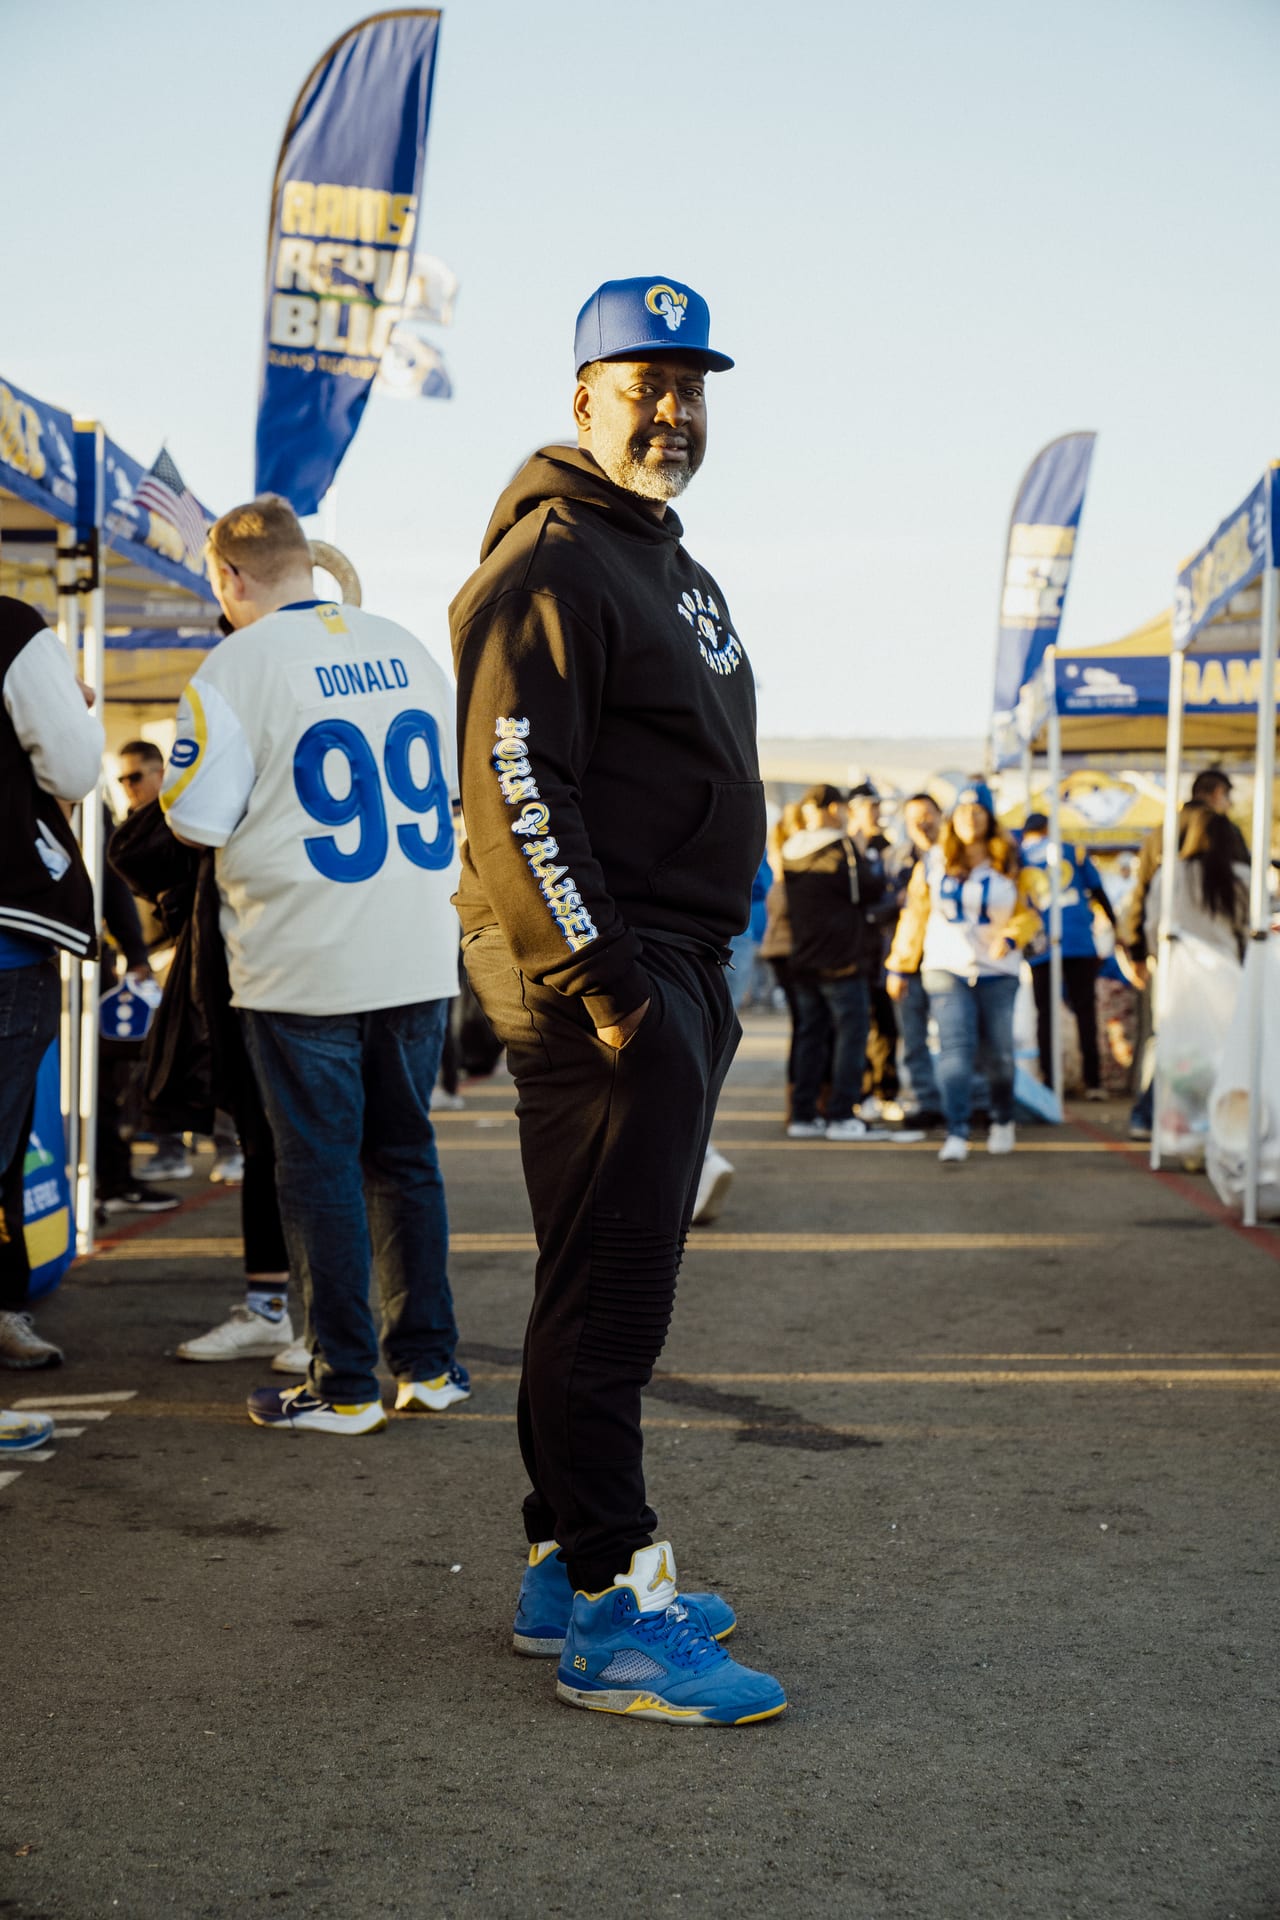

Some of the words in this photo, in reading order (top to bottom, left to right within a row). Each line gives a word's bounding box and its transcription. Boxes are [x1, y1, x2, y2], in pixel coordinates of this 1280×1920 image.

[281, 180, 417, 247] RAMS
[315, 659, 409, 698] DONALD
[1182, 658, 1280, 705] RAM
[492, 716, 541, 805] BORN
[293, 709, 454, 883] 99
[574, 1655, 586, 1671] 23
